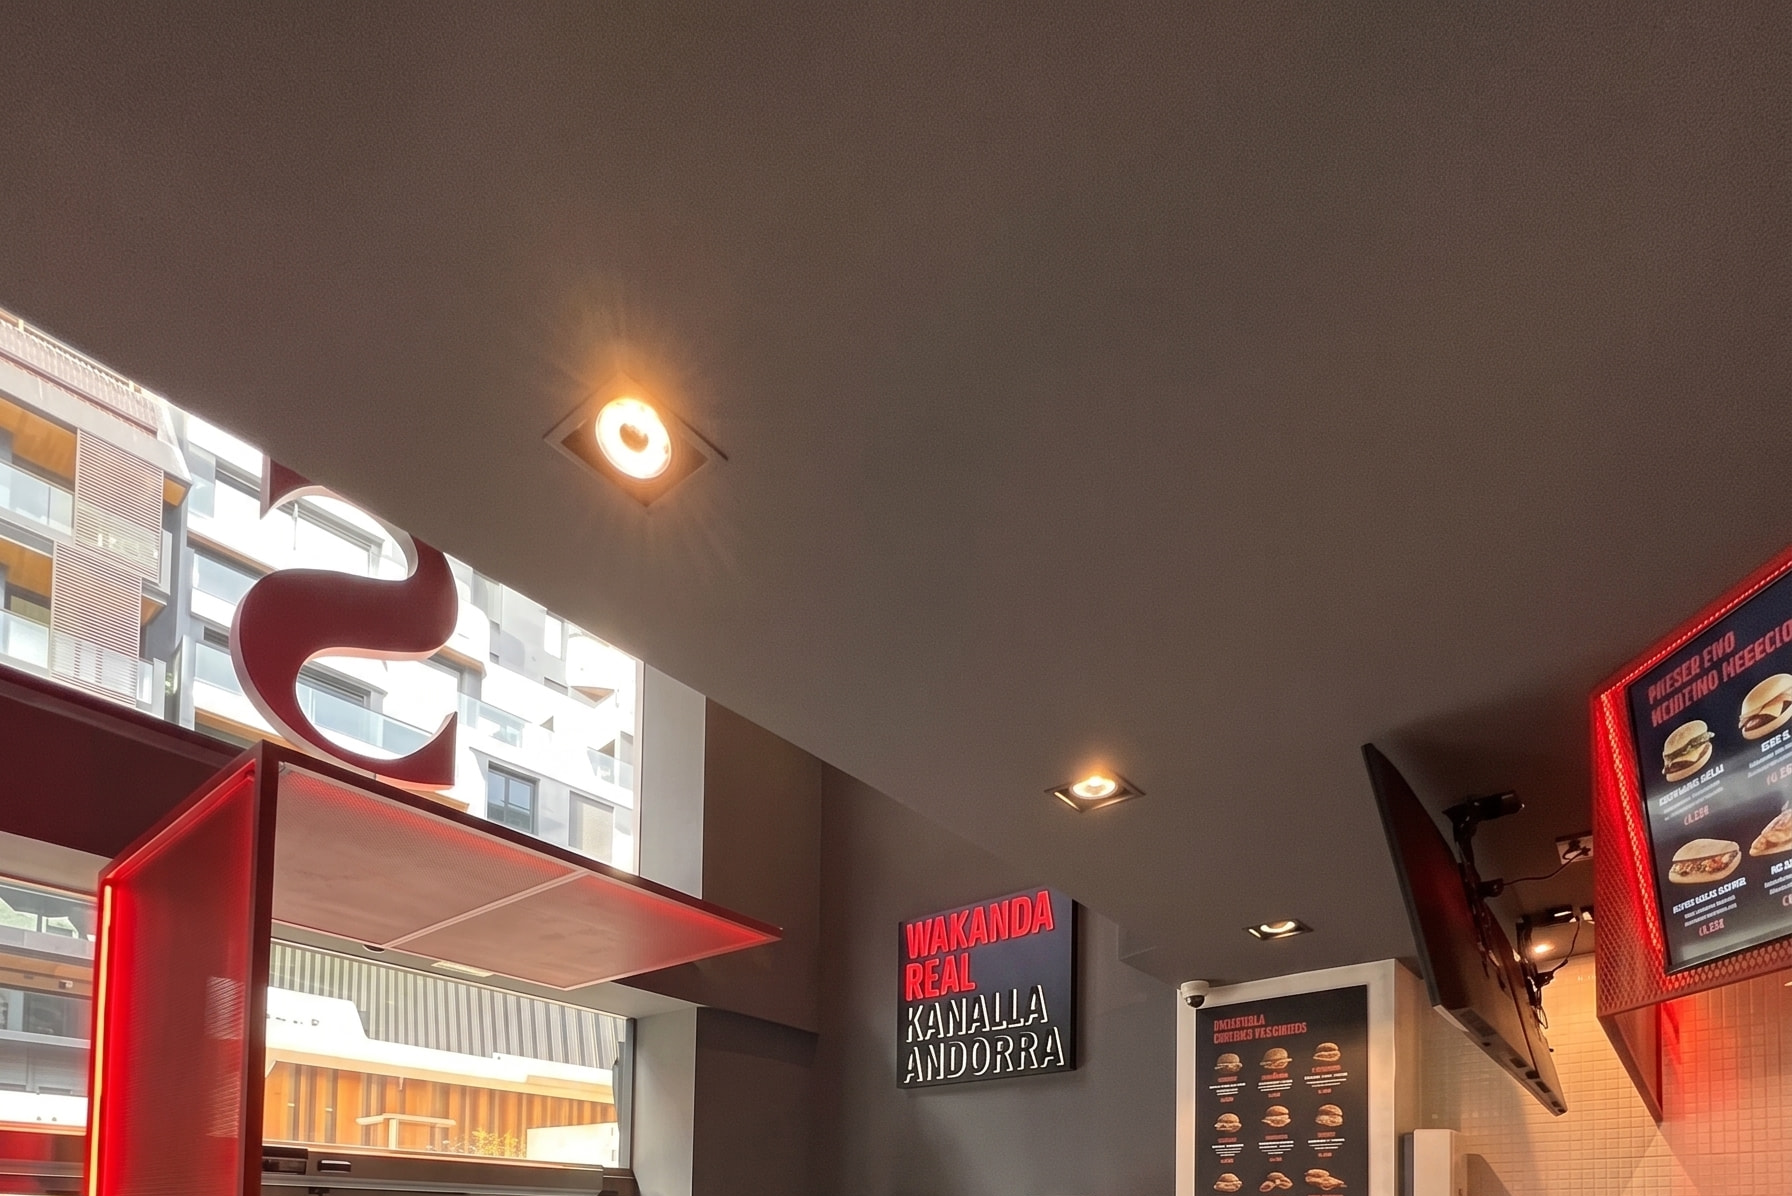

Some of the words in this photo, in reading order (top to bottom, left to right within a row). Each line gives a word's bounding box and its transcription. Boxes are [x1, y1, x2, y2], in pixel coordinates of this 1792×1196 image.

[906, 890, 1054, 959] WAKANDA
[905, 952, 976, 1001] REAL
[905, 984, 1049, 1043] KANALLA
[903, 1026, 1065, 1084] ANDORRA
